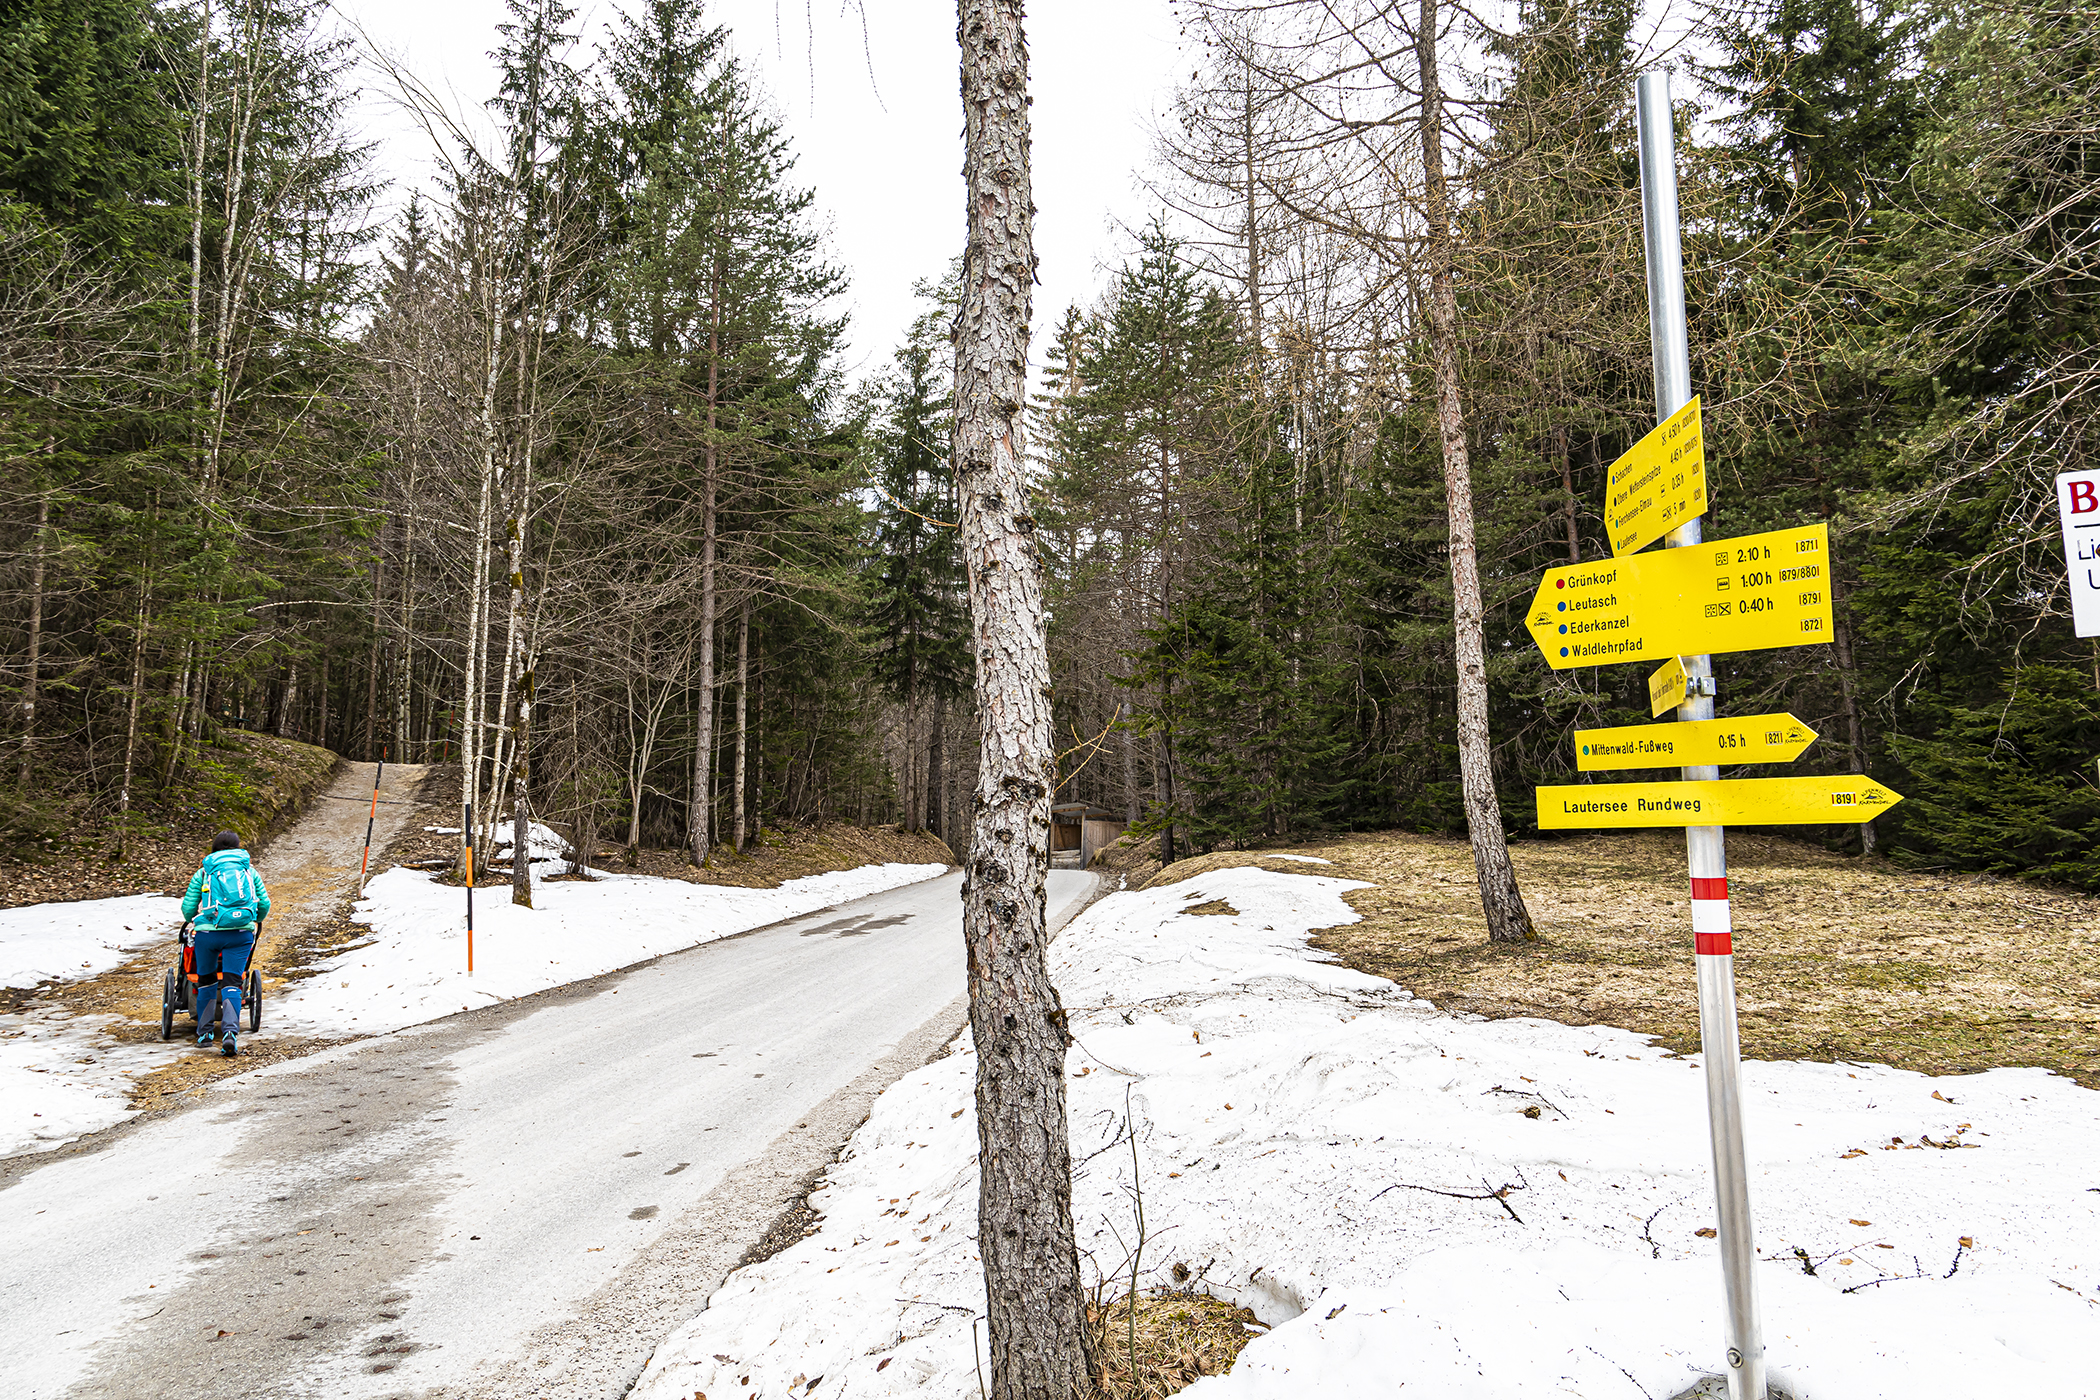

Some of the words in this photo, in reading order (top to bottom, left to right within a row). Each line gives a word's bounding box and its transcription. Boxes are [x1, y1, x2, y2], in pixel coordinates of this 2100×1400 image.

[1568, 569, 1617, 589] Grünkopf
[1737, 546, 1760, 563] 2:10
[1763, 545, 1771, 559] h
[1800, 539, 1814, 552] 871
[1569, 593, 1617, 612] Leutasch
[1740, 571, 1763, 588] 1:00
[1765, 571, 1772, 585] h
[1781, 565, 1817, 581] 879/880
[1570, 615, 1630, 635] Ederkanzel
[1739, 597, 1765, 614] 0:40
[1766, 597, 1774, 611] h
[1802, 592, 1818, 605] 879
[1571, 637, 1643, 657] Waldlehrpfad
[1803, 618, 1819, 631] 872
[1591, 739, 1674, 756] Mittenwald-Fußweg
[1718, 734, 1737, 749] 0:15
[1739, 733, 1746, 747] h
[1768, 732, 1780, 744] 821
[1563, 800, 1628, 813] Lautersee
[1637, 798, 1701, 813] Rundweg
[1836, 793, 1851, 804] 819
